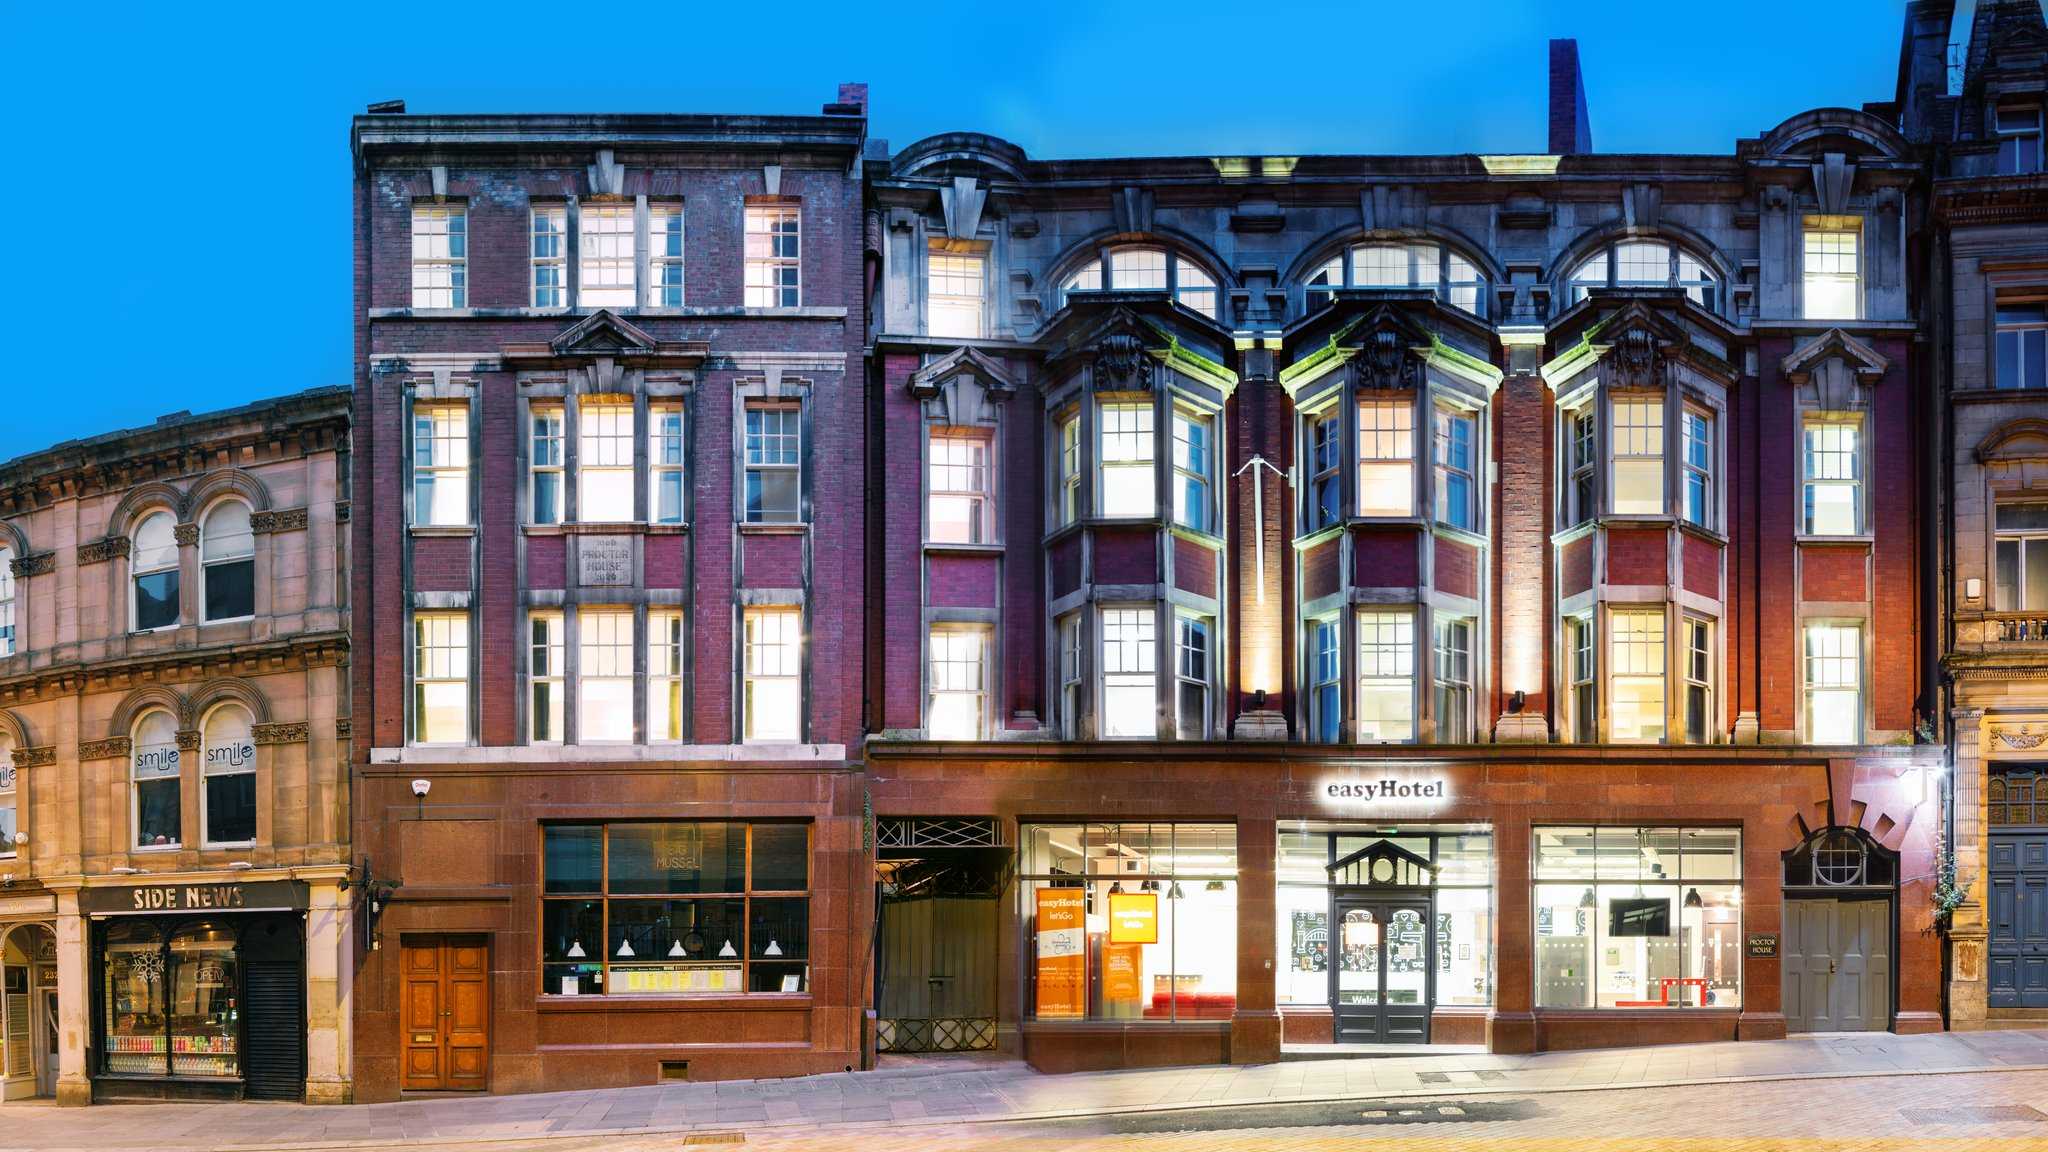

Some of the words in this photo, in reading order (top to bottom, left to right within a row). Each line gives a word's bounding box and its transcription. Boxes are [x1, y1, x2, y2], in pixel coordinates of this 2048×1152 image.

[586, 561, 623, 571] HOUSE
[137, 747, 179, 770] smile
[207, 742, 253, 765] smile
[1327, 780, 1444, 801] easyHotel
[133, 888, 177, 909] SIDE
[186, 886, 244, 908] NEWS
[1351, 995, 1394, 1005] Welcoe
